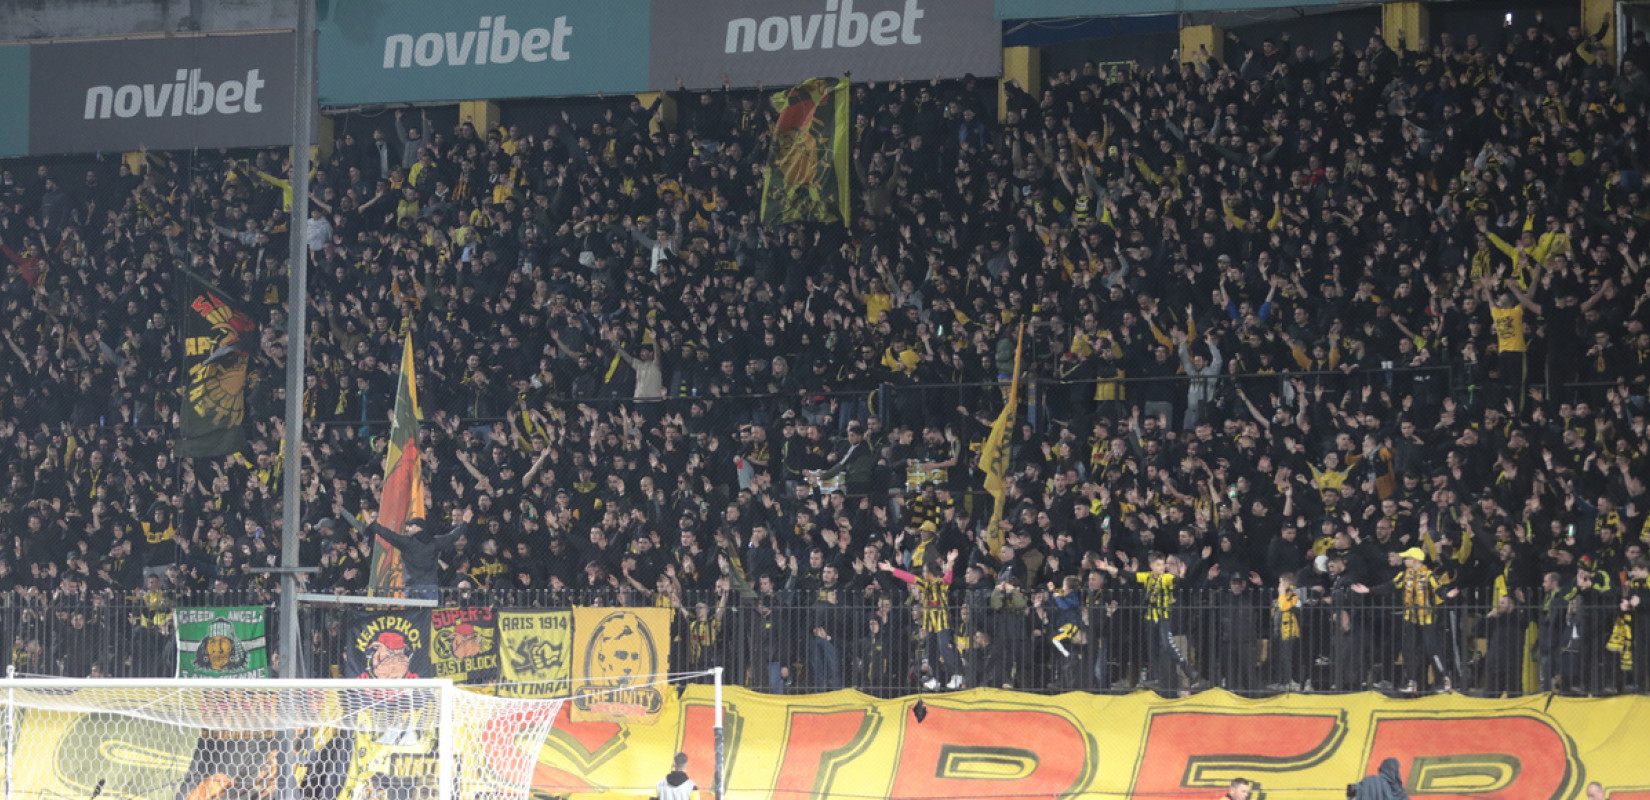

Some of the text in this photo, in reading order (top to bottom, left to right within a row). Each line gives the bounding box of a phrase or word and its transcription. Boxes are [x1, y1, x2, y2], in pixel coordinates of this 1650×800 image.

[724, 0, 925, 54] novibet
[383, 15, 573, 69] novibet
[84, 68, 265, 120] novibet
[431, 606, 493, 630] SUPER-3
[502, 616, 567, 631] ARIS 1914
[436, 660, 462, 676] EAST
[465, 654, 497, 671] BLOCK
[583, 689, 609, 706] THE
[613, 688, 654, 710] UNITY
